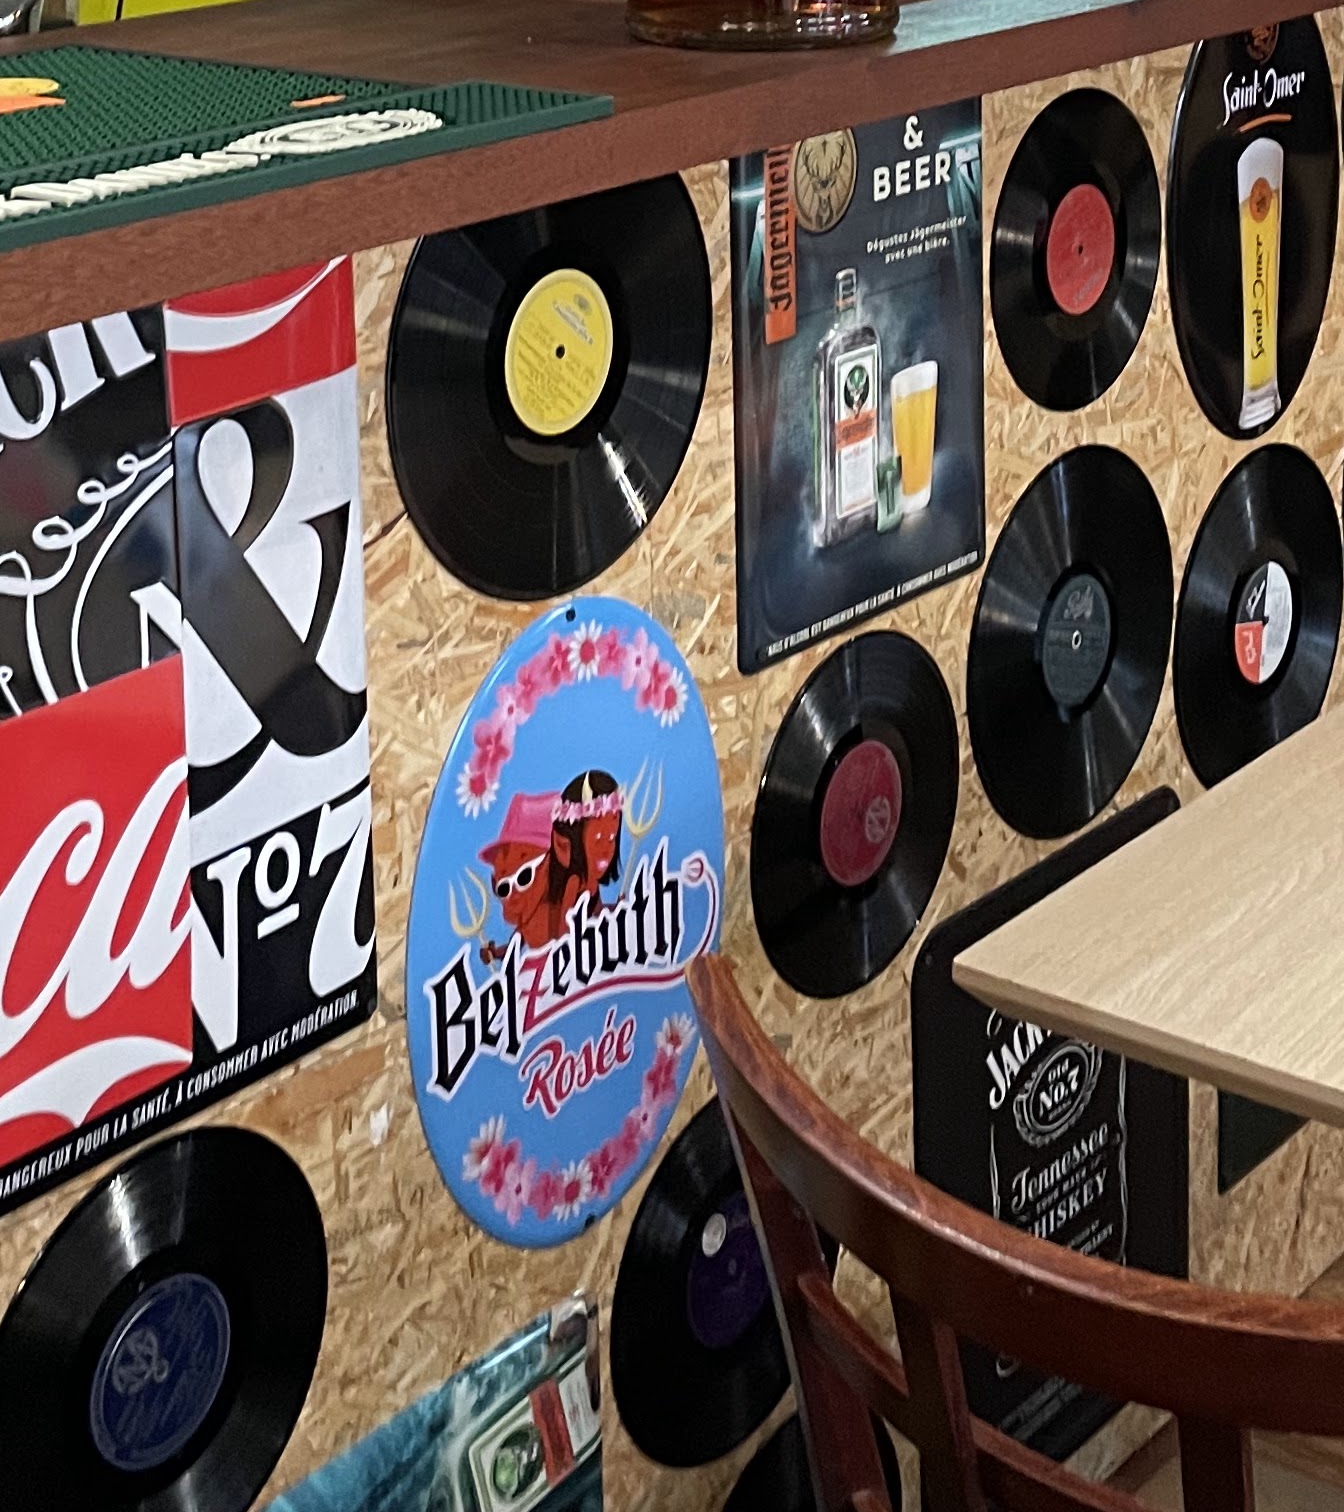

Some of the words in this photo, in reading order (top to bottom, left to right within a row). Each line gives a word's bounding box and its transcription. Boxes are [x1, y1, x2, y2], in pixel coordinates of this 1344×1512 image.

[873, 151, 951, 202] BEER
[903, 115, 923, 151] &
[431, 844, 682, 1093] Belzebuth
[75, 1123, 109, 1161] POUR
[113, 1114, 127, 1140] LA
[186, 1045, 258, 1099] CONSOMMER
[260, 1027, 289, 1061] AVEC
[522, 1008, 635, 1117] Rosée
[1011, 1123, 1109, 1215] Tennessee
